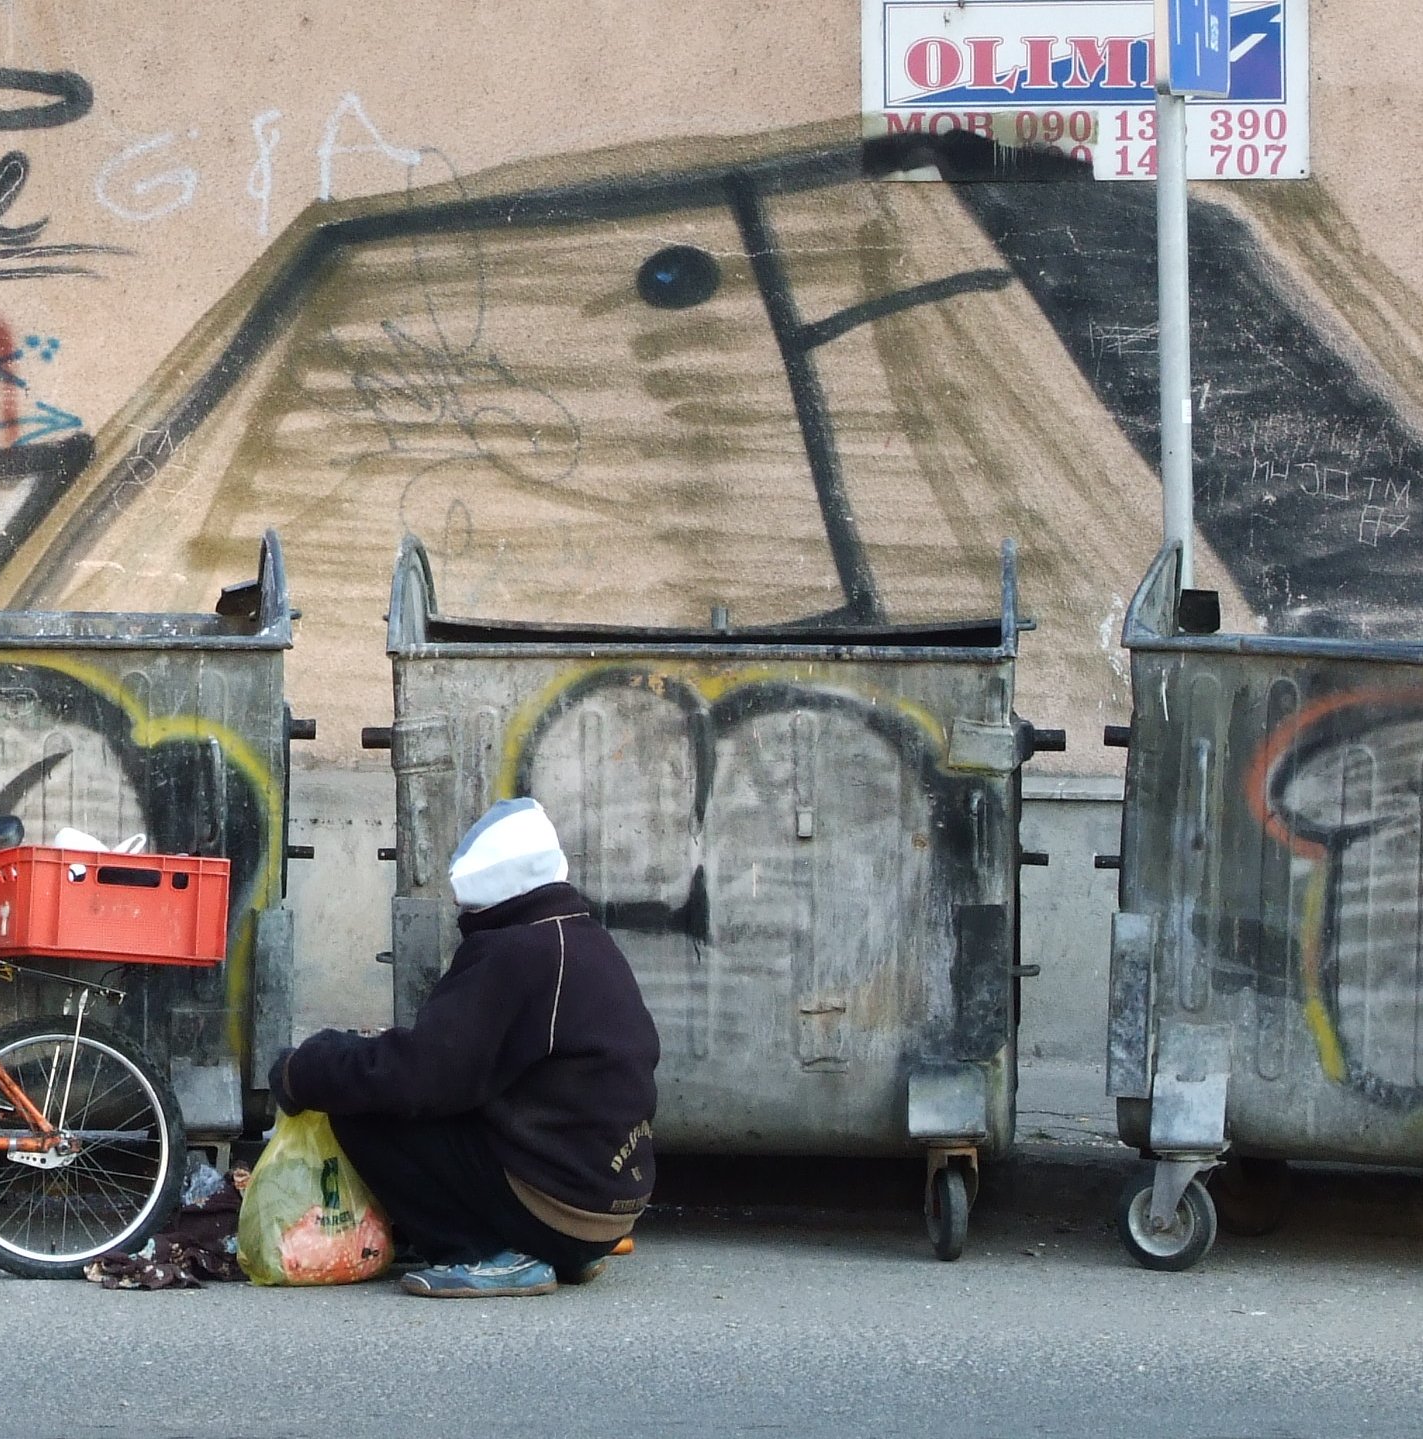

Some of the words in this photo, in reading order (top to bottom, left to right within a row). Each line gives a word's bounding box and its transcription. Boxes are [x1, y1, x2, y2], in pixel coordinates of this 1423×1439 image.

[904, 36, 1154, 92] OLIM
[1015, 110, 1092, 142] 090
[1115, 110, 1187, 141] 13
[1210, 109, 1287, 141] 390
[1115, 145, 1187, 175] 14
[1210, 144, 1287, 175] 707
